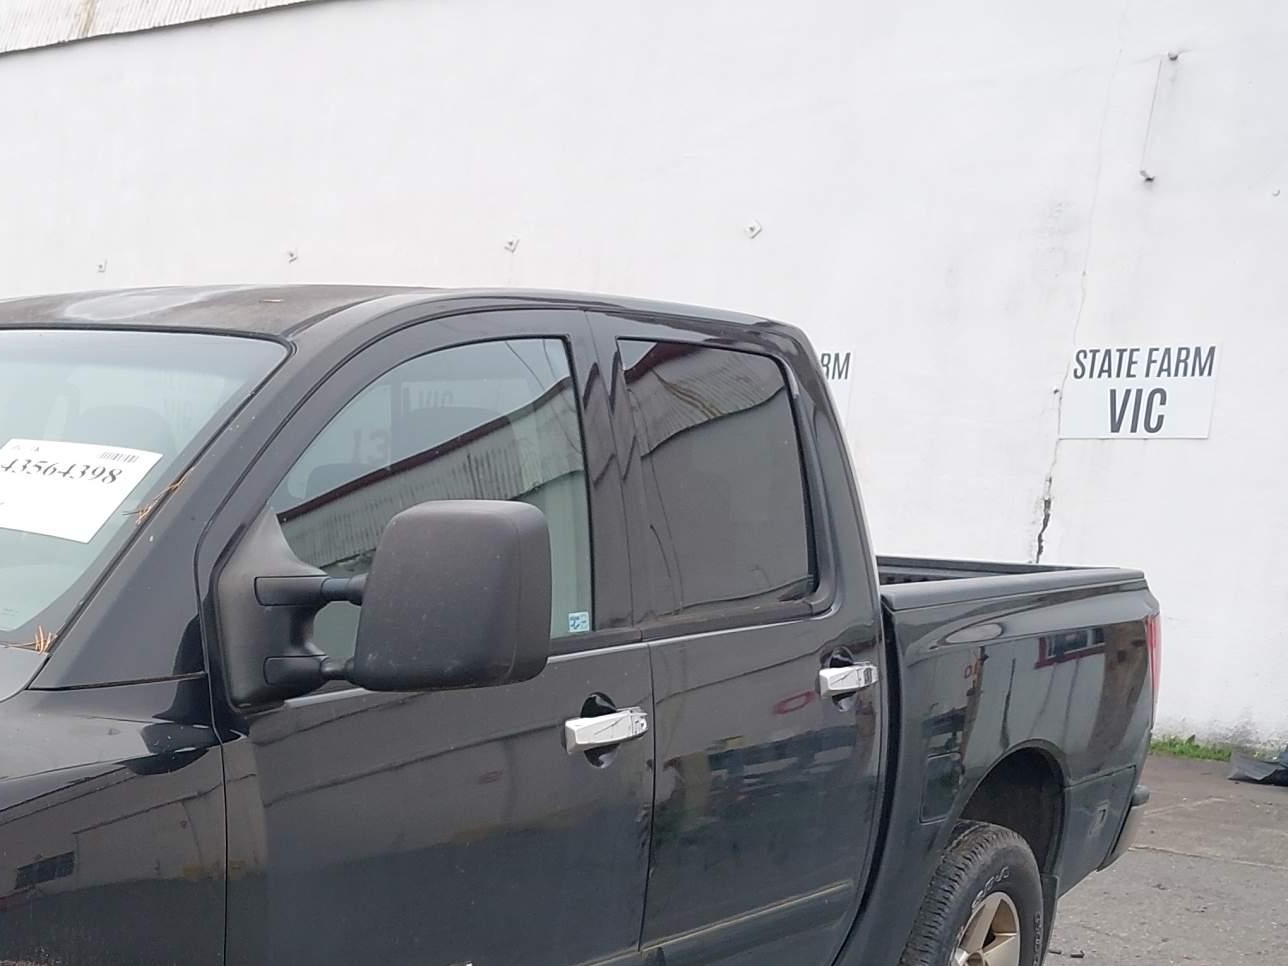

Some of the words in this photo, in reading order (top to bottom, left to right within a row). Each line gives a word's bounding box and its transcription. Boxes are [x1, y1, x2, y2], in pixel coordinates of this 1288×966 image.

[820, 352, 851, 380] RM
[1073, 348, 1140, 379] STATE
[1145, 346, 1216, 378] FARM
[1109, 387, 1167, 433] VIC
[0, 458, 123, 485] 43564398
